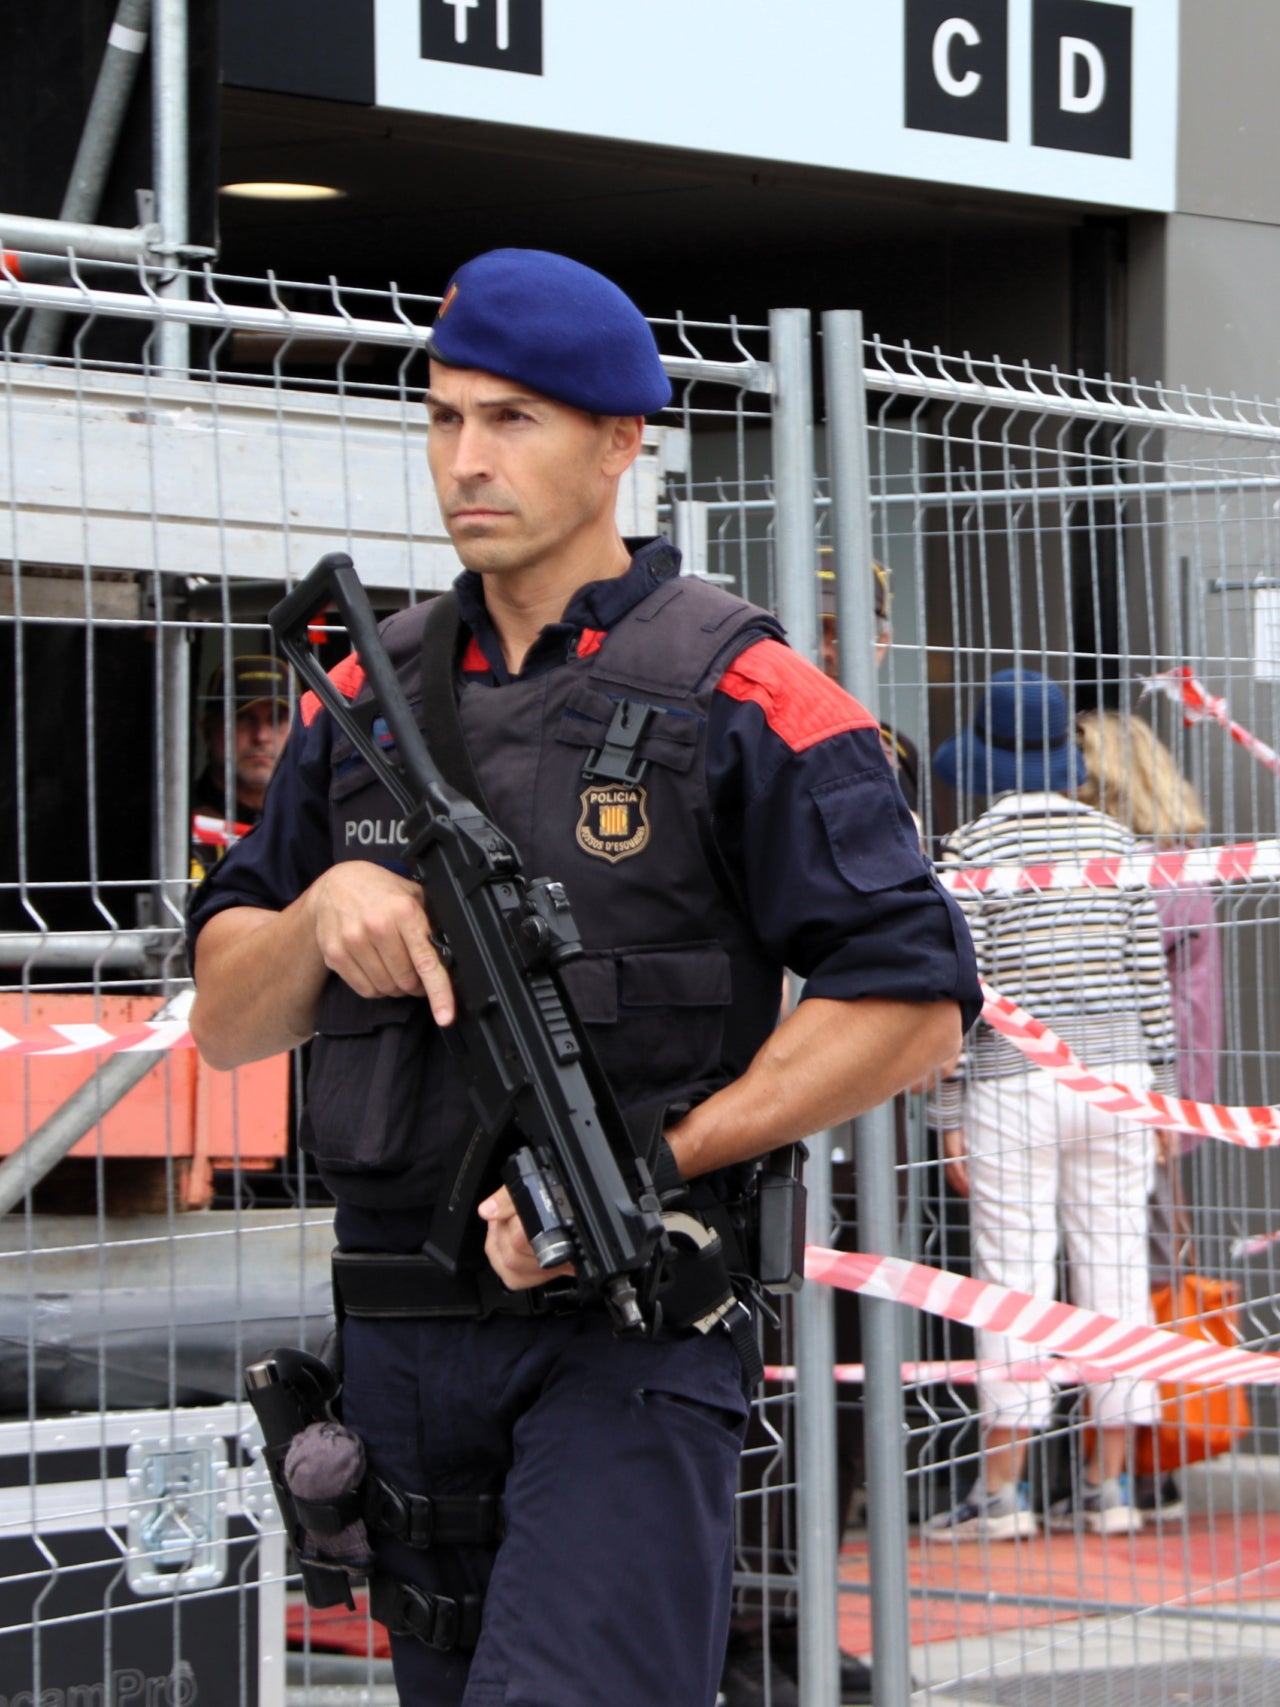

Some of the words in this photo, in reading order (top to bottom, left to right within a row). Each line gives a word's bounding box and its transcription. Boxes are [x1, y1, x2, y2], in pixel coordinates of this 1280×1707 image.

[932, 17, 982, 97] C
[1059, 35, 1107, 114] D
[590, 791, 638, 804] POLICIA
[345, 819, 409, 846] POLIC
